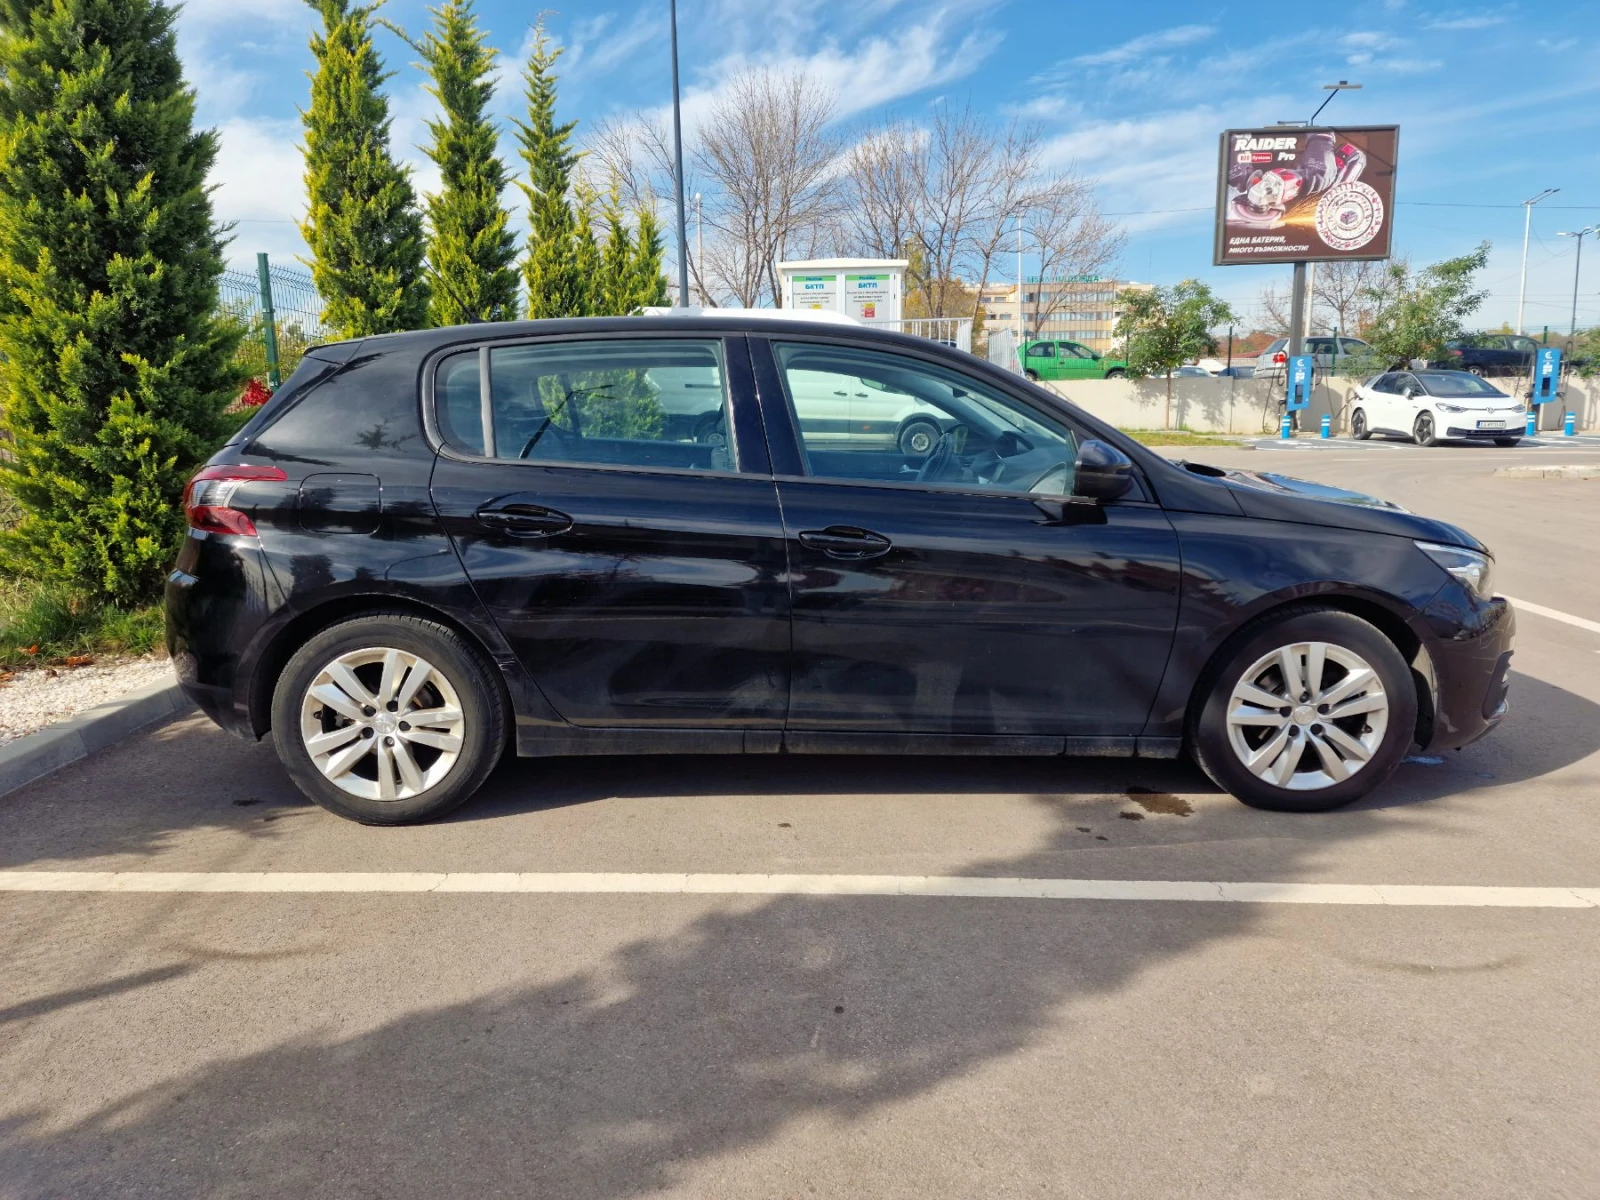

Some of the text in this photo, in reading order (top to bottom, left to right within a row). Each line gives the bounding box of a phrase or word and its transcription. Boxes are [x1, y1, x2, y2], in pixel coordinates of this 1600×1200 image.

[1234, 137, 1297, 151] RAIDER
[1278, 152, 1296, 161] Pro
[1229, 236, 1286, 245] ЕДНА БАТЕРИЯ,
